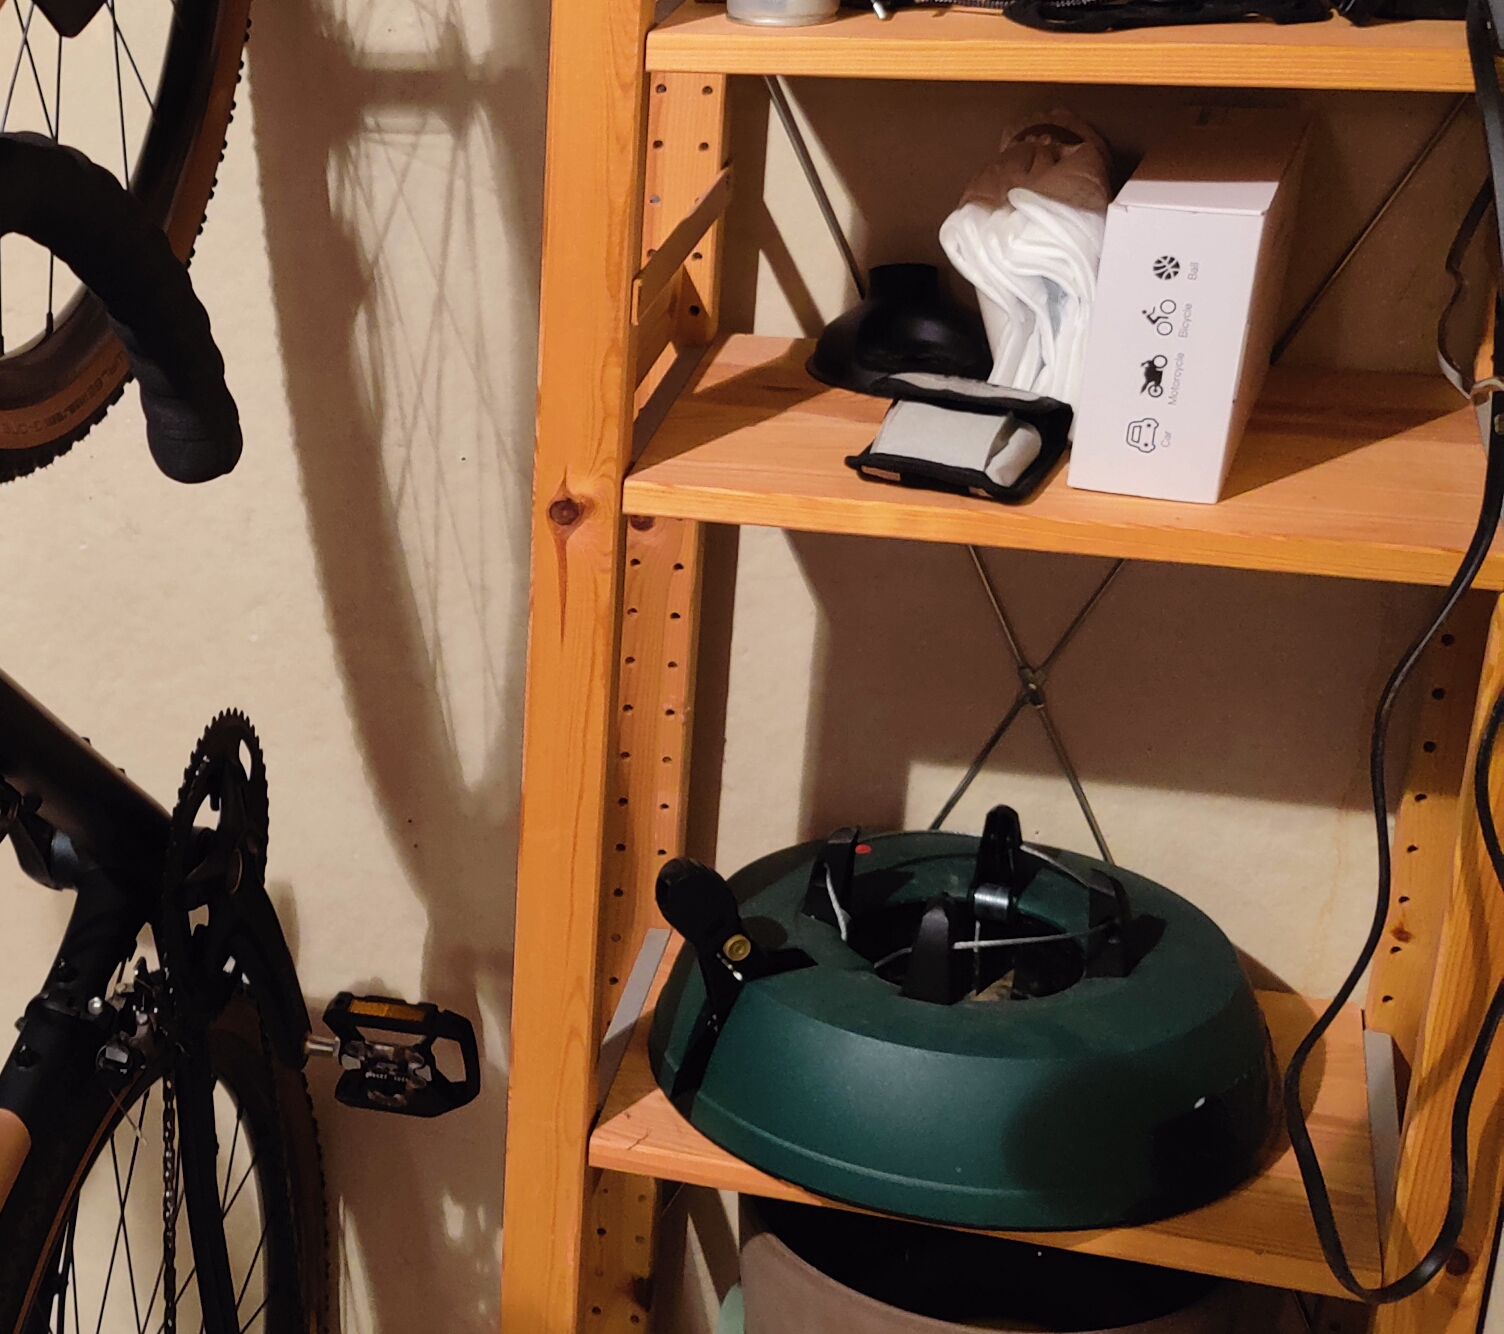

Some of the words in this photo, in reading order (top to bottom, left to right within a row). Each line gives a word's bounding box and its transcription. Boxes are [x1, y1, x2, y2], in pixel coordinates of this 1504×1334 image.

[1187, 261, 1199, 281] Ball
[1178, 302, 1193, 338] Bicycle
[1167, 352, 1185, 406] Motorcycle
[1160, 431, 1172, 448] Car
